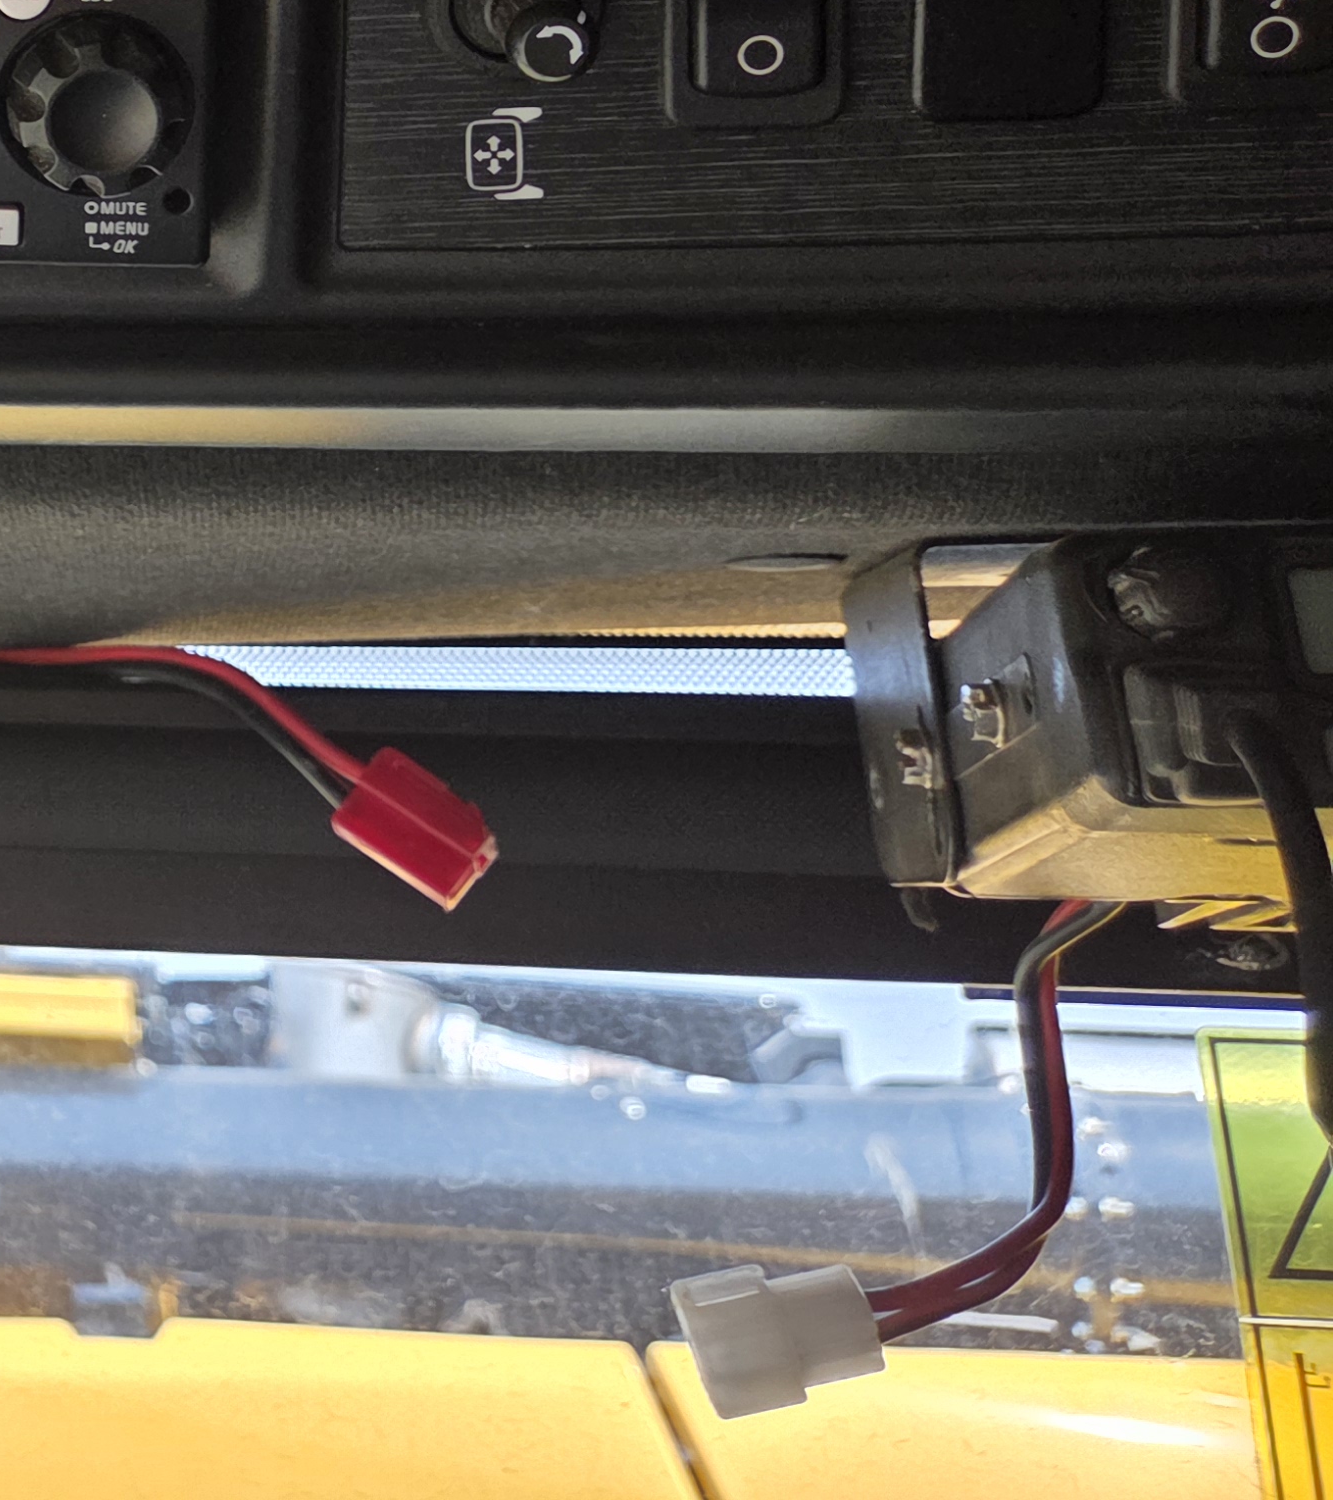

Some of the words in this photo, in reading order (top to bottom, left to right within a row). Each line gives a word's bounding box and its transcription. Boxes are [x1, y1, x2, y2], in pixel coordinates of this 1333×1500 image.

[100, 201, 147, 215] MUTE
[99, 221, 149, 235] MENU
[114, 240, 137, 253] OK
